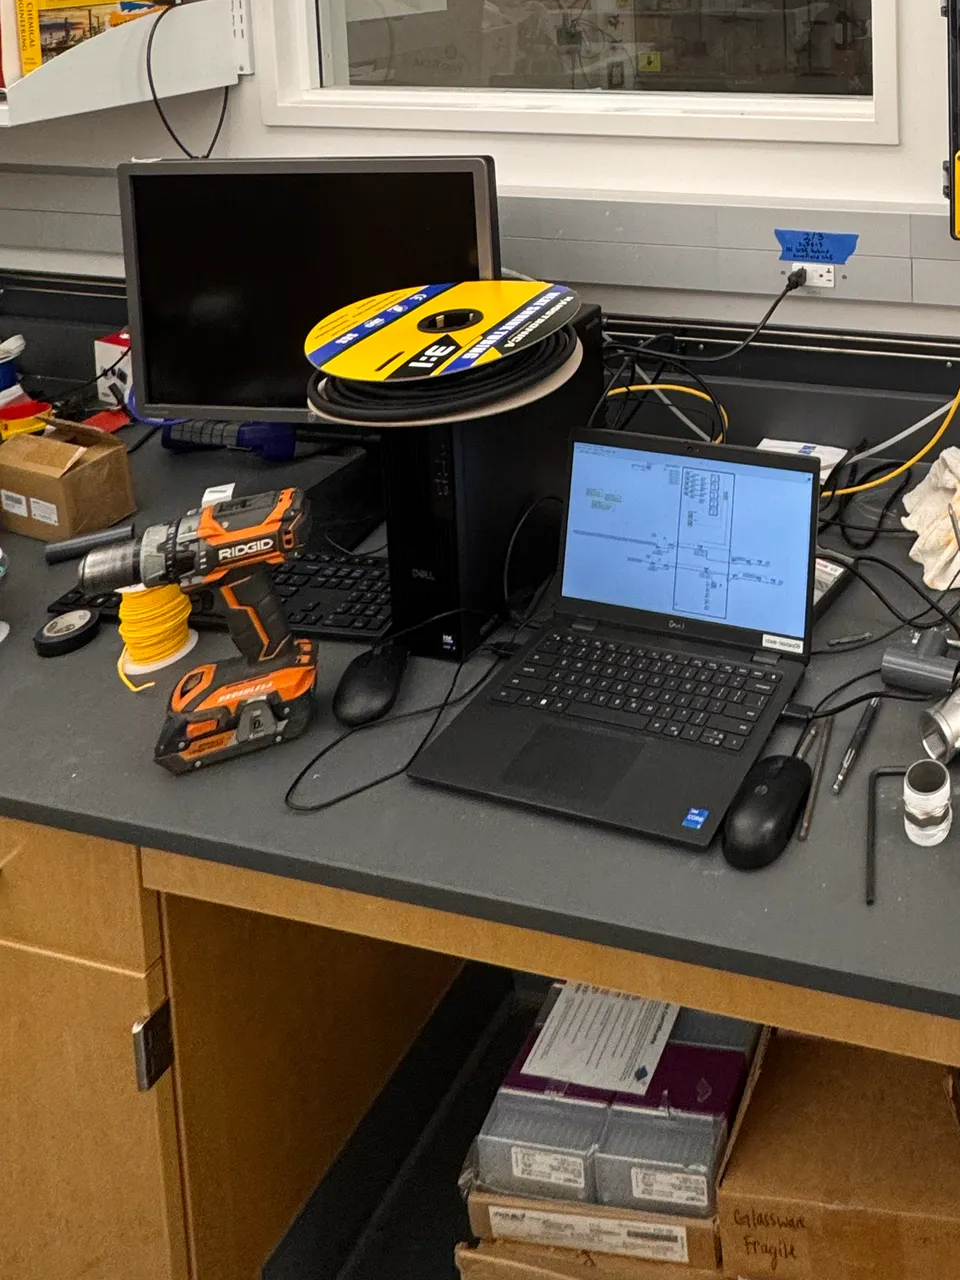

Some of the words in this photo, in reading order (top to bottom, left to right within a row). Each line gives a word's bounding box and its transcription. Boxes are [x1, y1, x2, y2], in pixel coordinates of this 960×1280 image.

[26, 2, 36, 48] CHEMICAL
[408, 344, 456, 370] 3:1
[462, 328, 507, 360] TUBING
[218, 538, 274, 561] RIDGID
[412, 568, 435, 580] DELL
[217, 682, 273, 703] BRUSHLESS
[743, 1234, 797, 1271] Fragile
